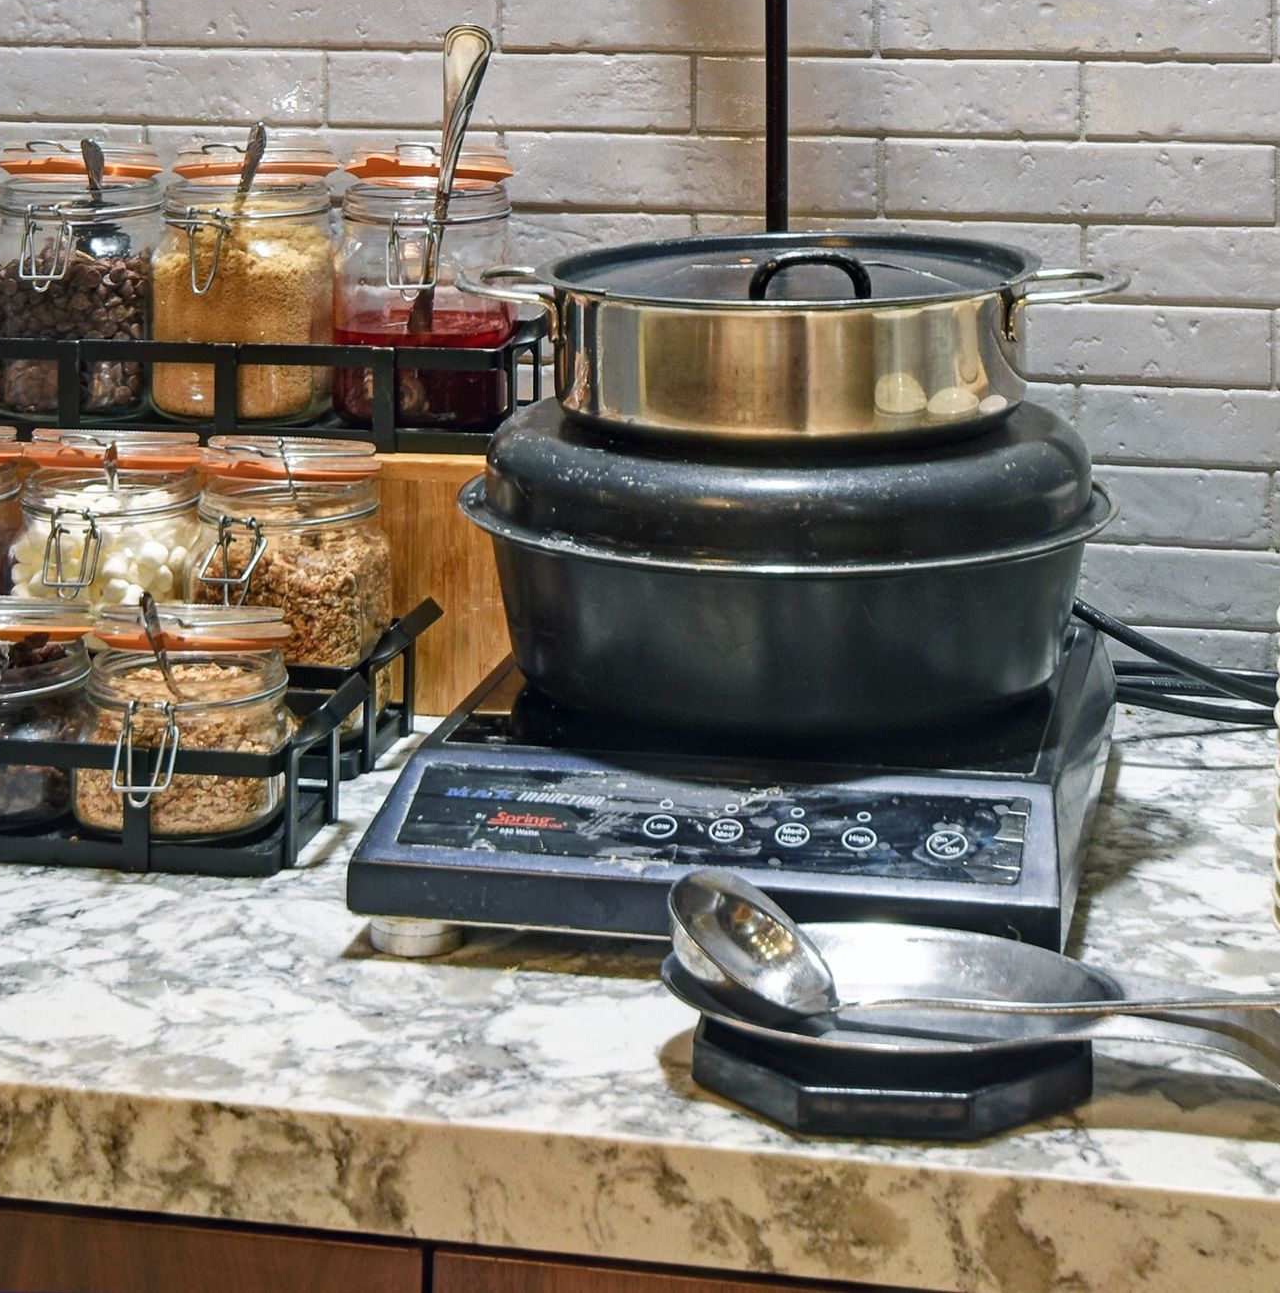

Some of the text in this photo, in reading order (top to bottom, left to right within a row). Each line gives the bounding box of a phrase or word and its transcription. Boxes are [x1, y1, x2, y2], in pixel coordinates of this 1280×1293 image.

[489, 811, 556, 827] Spring
[650, 821, 670, 830] Low
[780, 834, 803, 843] High
[848, 834, 871, 844] High
